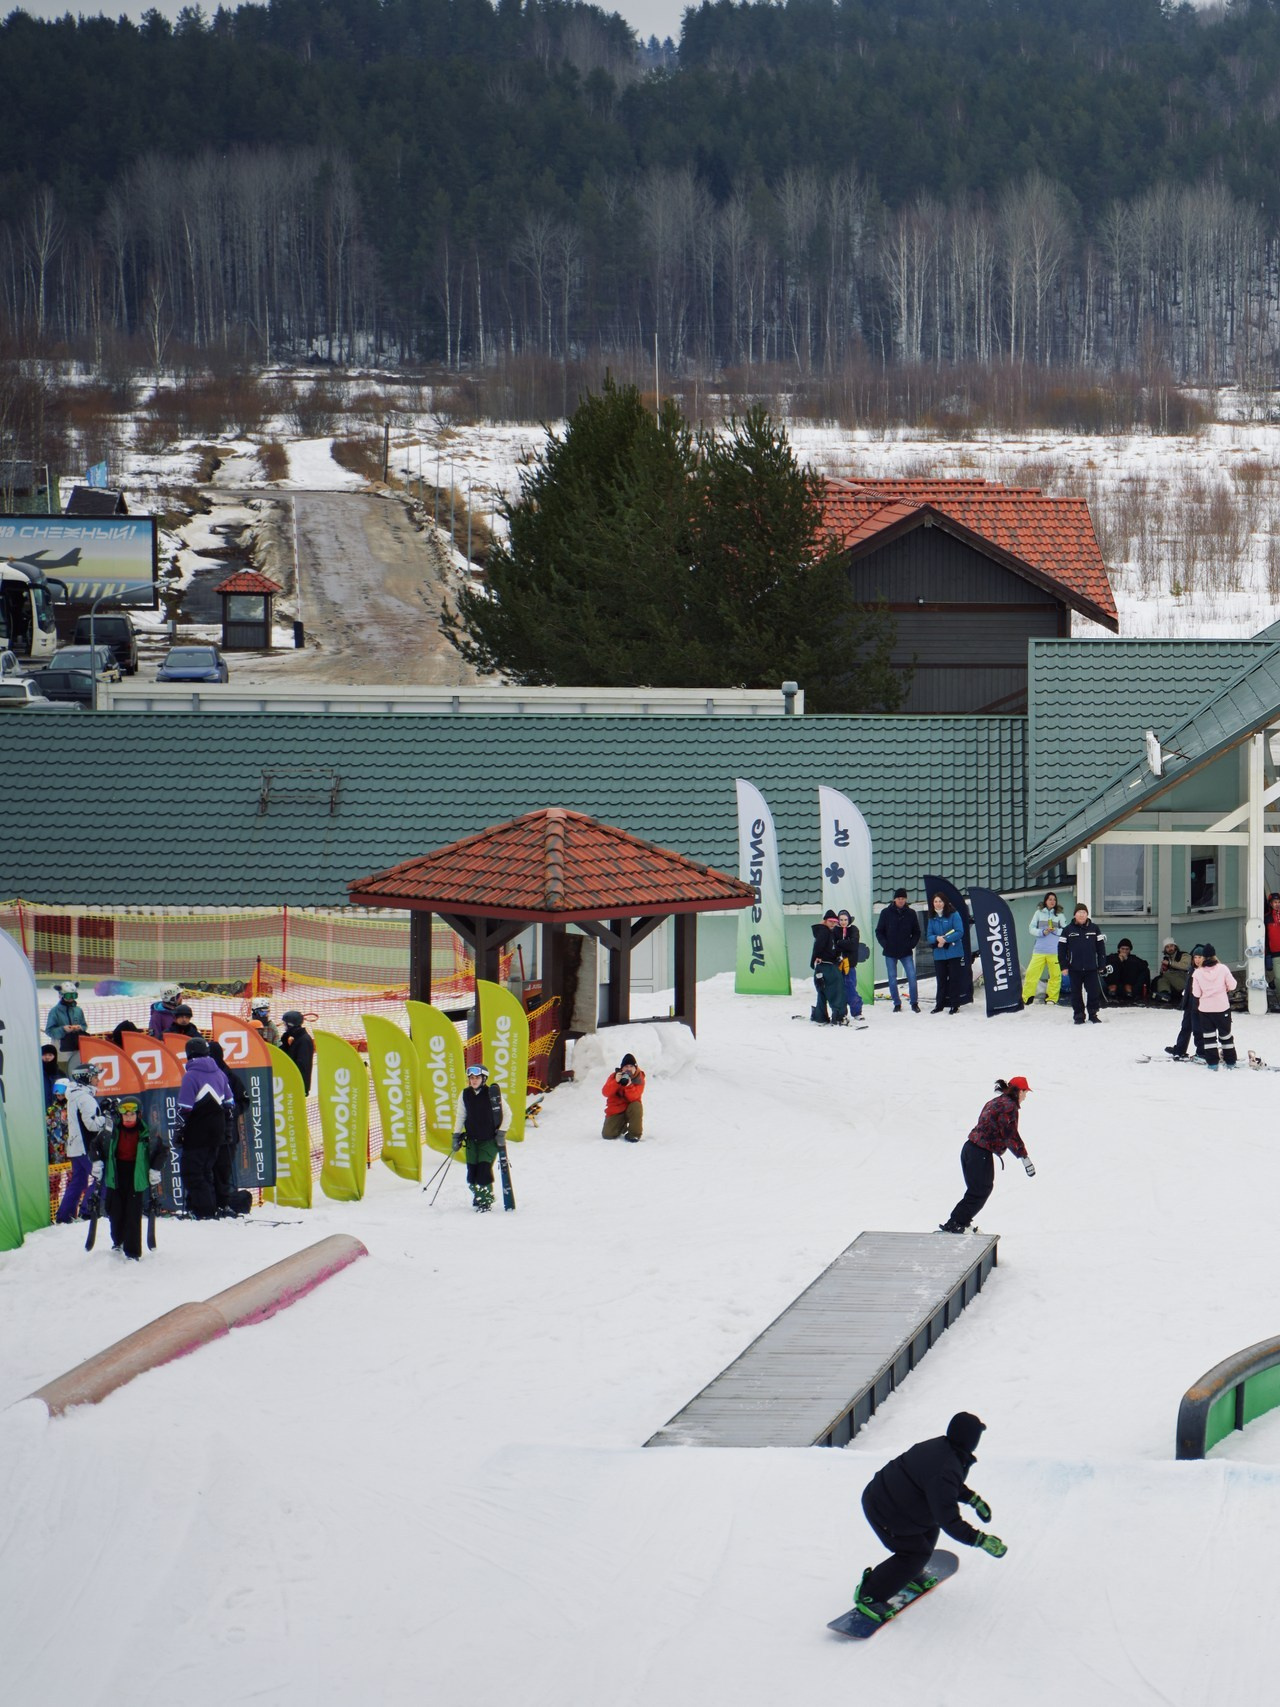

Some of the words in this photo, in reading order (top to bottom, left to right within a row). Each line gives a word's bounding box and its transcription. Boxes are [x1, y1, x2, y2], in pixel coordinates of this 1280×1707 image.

[20, 525, 137, 541] СНЕЖНЫЙ!
[986, 911, 1009, 992] invoke
[1002, 923, 1011, 947] DRINK
[382, 1051, 408, 1148] invoke
[427, 1035, 453, 1130] invoke
[286, 1093, 295, 1122] DRINK
[329, 1067, 350, 1169] invoke
[350, 1086, 359, 1117] DRINK
[406, 1098, 414, 1134] ENERGY
[288, 1127, 299, 1162] ENERGY
